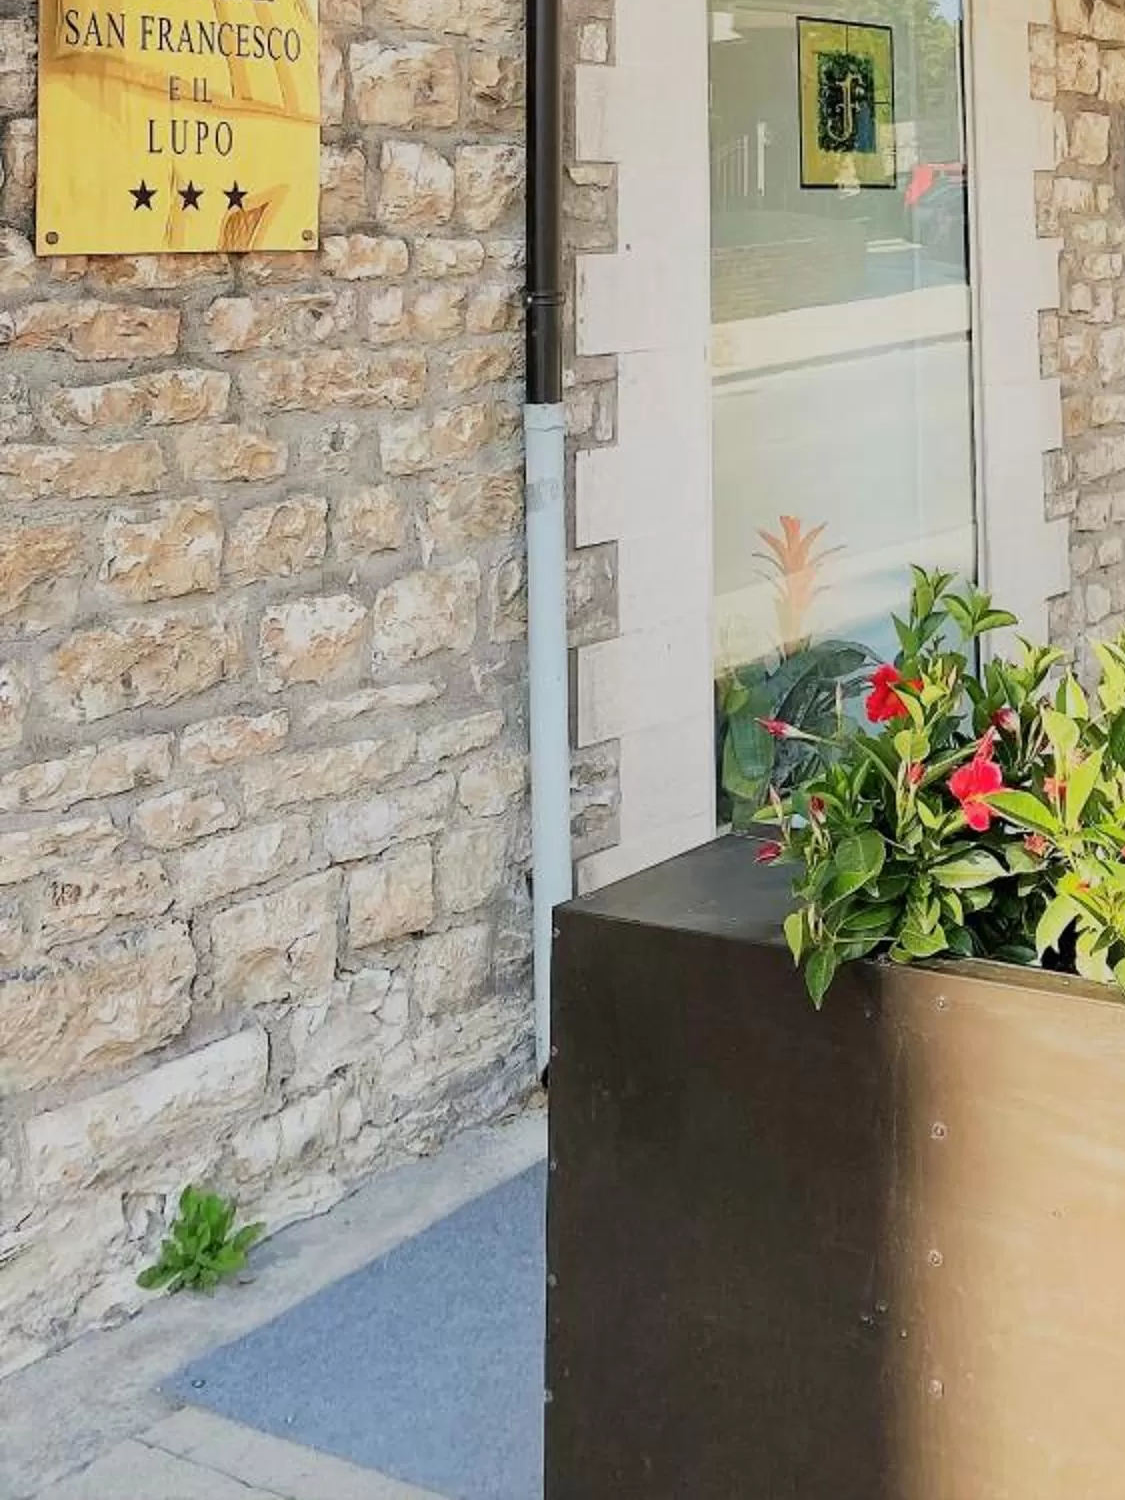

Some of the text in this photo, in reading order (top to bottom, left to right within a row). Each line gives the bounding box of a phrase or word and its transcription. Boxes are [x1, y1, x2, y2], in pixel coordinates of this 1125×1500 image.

[64, 9, 301, 62] SAN FRANCESCO
[168, 76, 213, 103] E IL
[147, 119, 234, 156] LUPO
